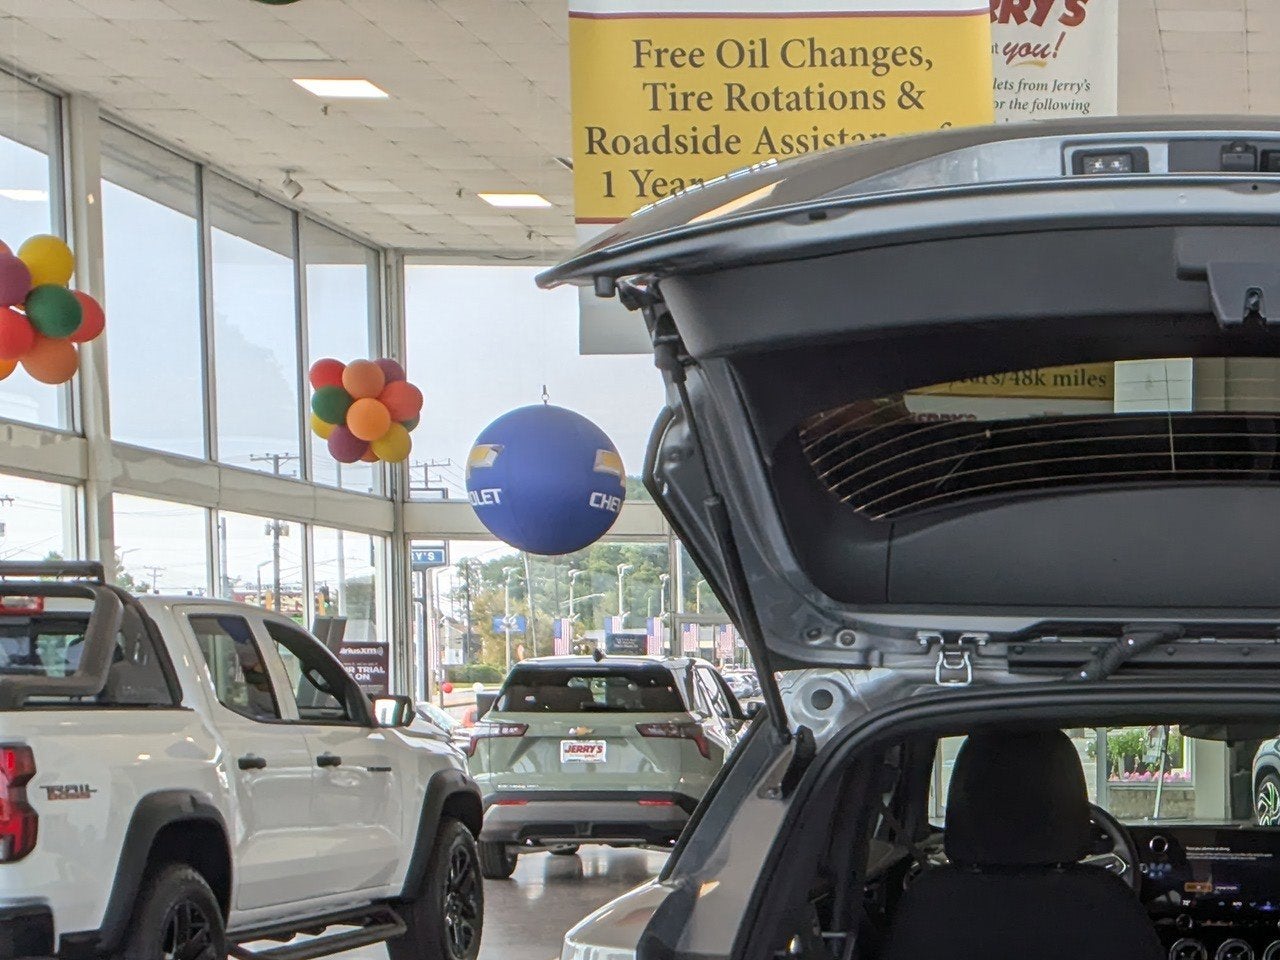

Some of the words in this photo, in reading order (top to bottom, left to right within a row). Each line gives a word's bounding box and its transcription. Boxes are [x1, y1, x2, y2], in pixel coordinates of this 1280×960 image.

[632, 38, 705, 69] Free
[716, 37, 770, 69] Oil
[780, 37, 933, 77] Changes,
[1002, 31, 1066, 65] you!
[642, 82, 713, 112] Tire
[724, 81, 886, 112] Rotations
[897, 81, 925, 110] &
[1015, 78, 1048, 94] from
[1052, 79, 1091, 95] Jerry's
[1009, 99, 1029, 110] the
[1030, 98, 1091, 115] following
[585, 124, 741, 155] Roadside
[602, 170, 616, 198] 1
[1053, 368, 1106, 387] miles
[564, 745, 603, 753] JERRY'S
